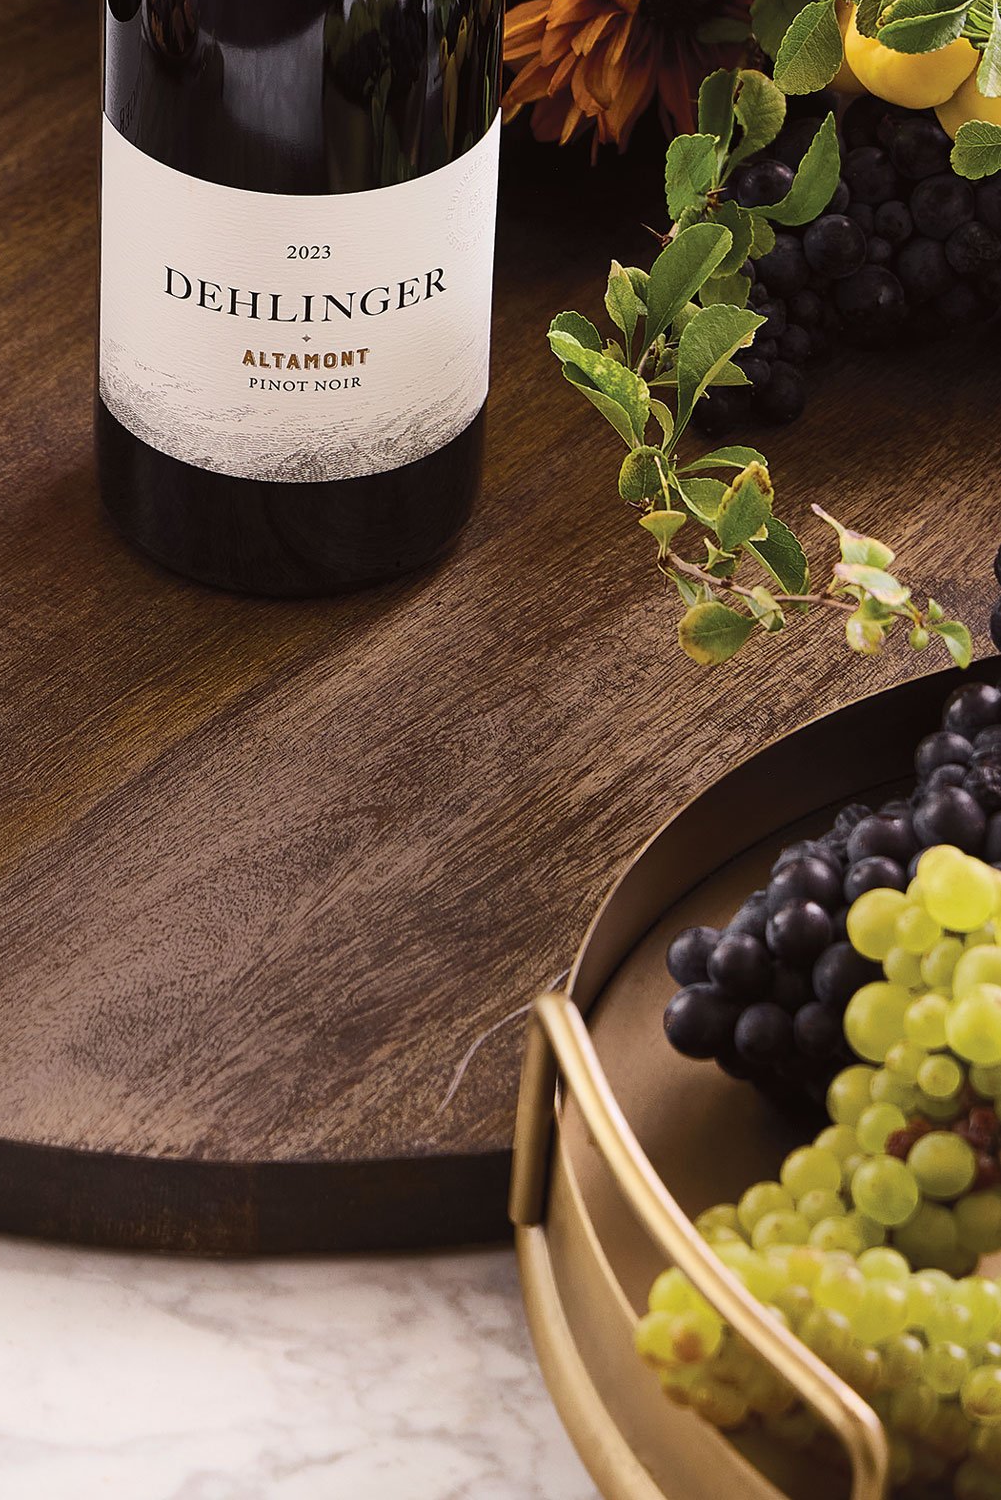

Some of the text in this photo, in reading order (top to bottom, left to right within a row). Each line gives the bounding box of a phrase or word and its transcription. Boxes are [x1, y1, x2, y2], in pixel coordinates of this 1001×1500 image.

[286, 245, 331, 260] 2023
[163, 265, 448, 322] DEHLINGER
[241, 347, 371, 371] ALTAMONT
[248, 376, 362, 392] PINOT NOIR
